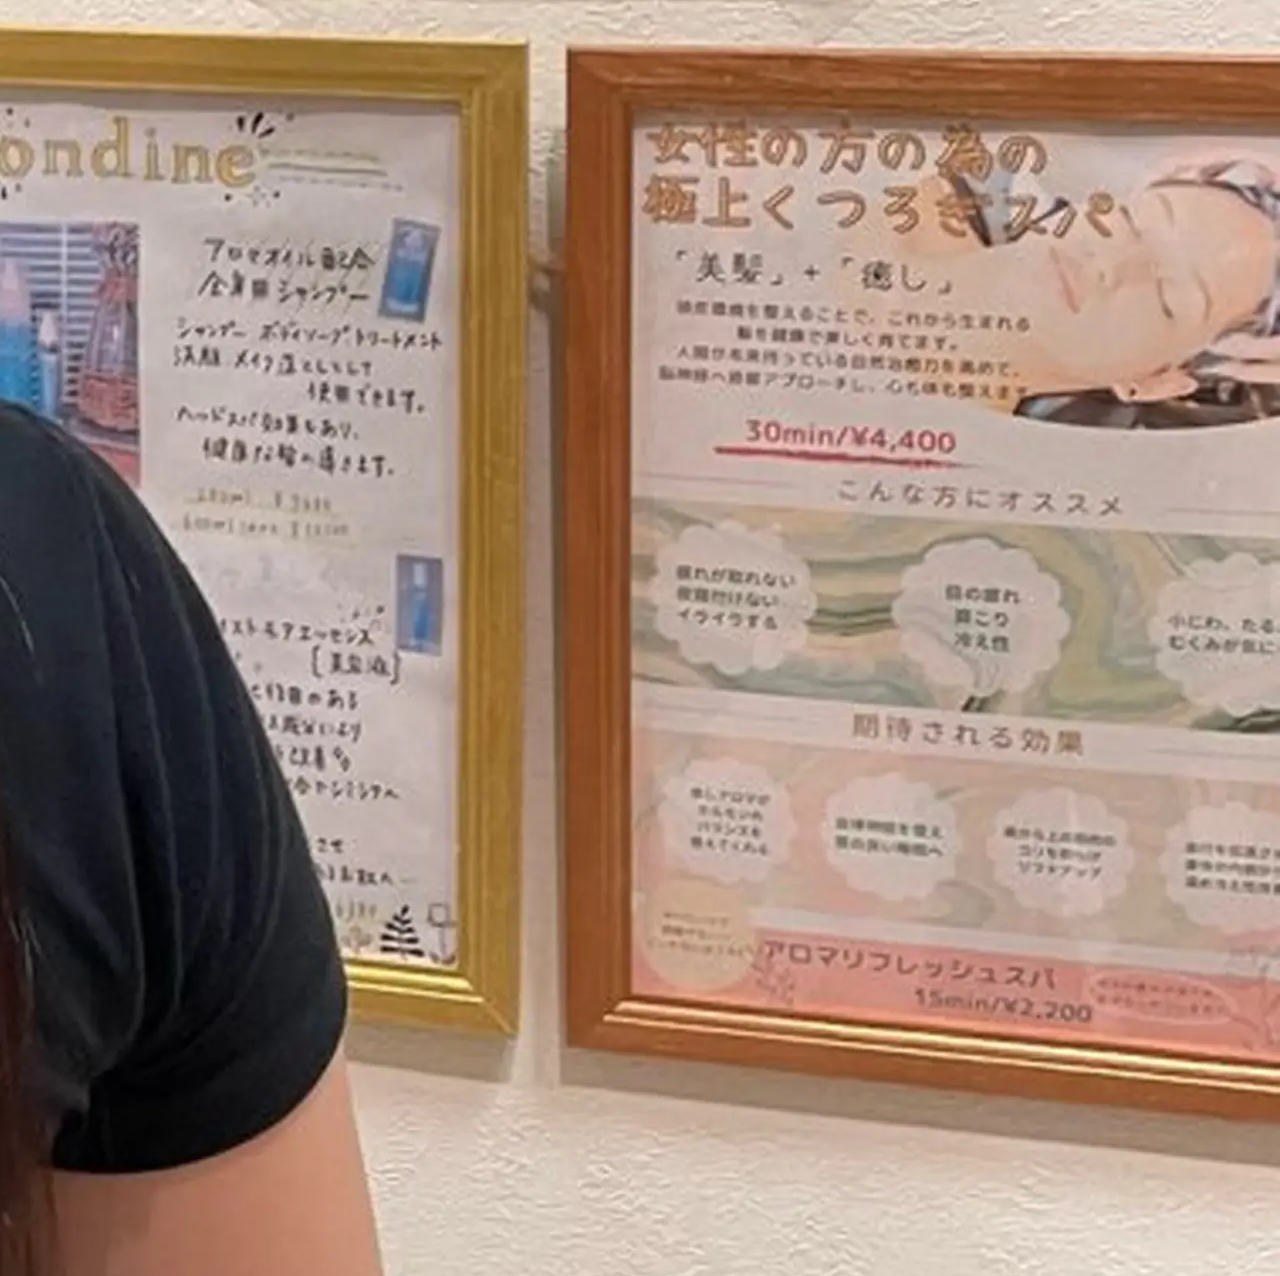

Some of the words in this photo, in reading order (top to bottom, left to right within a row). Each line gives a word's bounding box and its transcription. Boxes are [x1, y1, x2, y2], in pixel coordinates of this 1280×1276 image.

[646, 123, 1048, 181] 女性の方の為の
[642, 174, 1114, 241] 極上くつろぎスパ
[746, 419, 957, 455] 30min/¥4,400
[838, 478, 1124, 517] こんな方にオススメ
[676, 608, 778, 631] イライラする
[1167, 613, 1280, 635] 小じわ、たる
[852, 713, 1084, 756] 期待される効果
[764, 939, 1057, 991] アロマリフレッシュスパ
